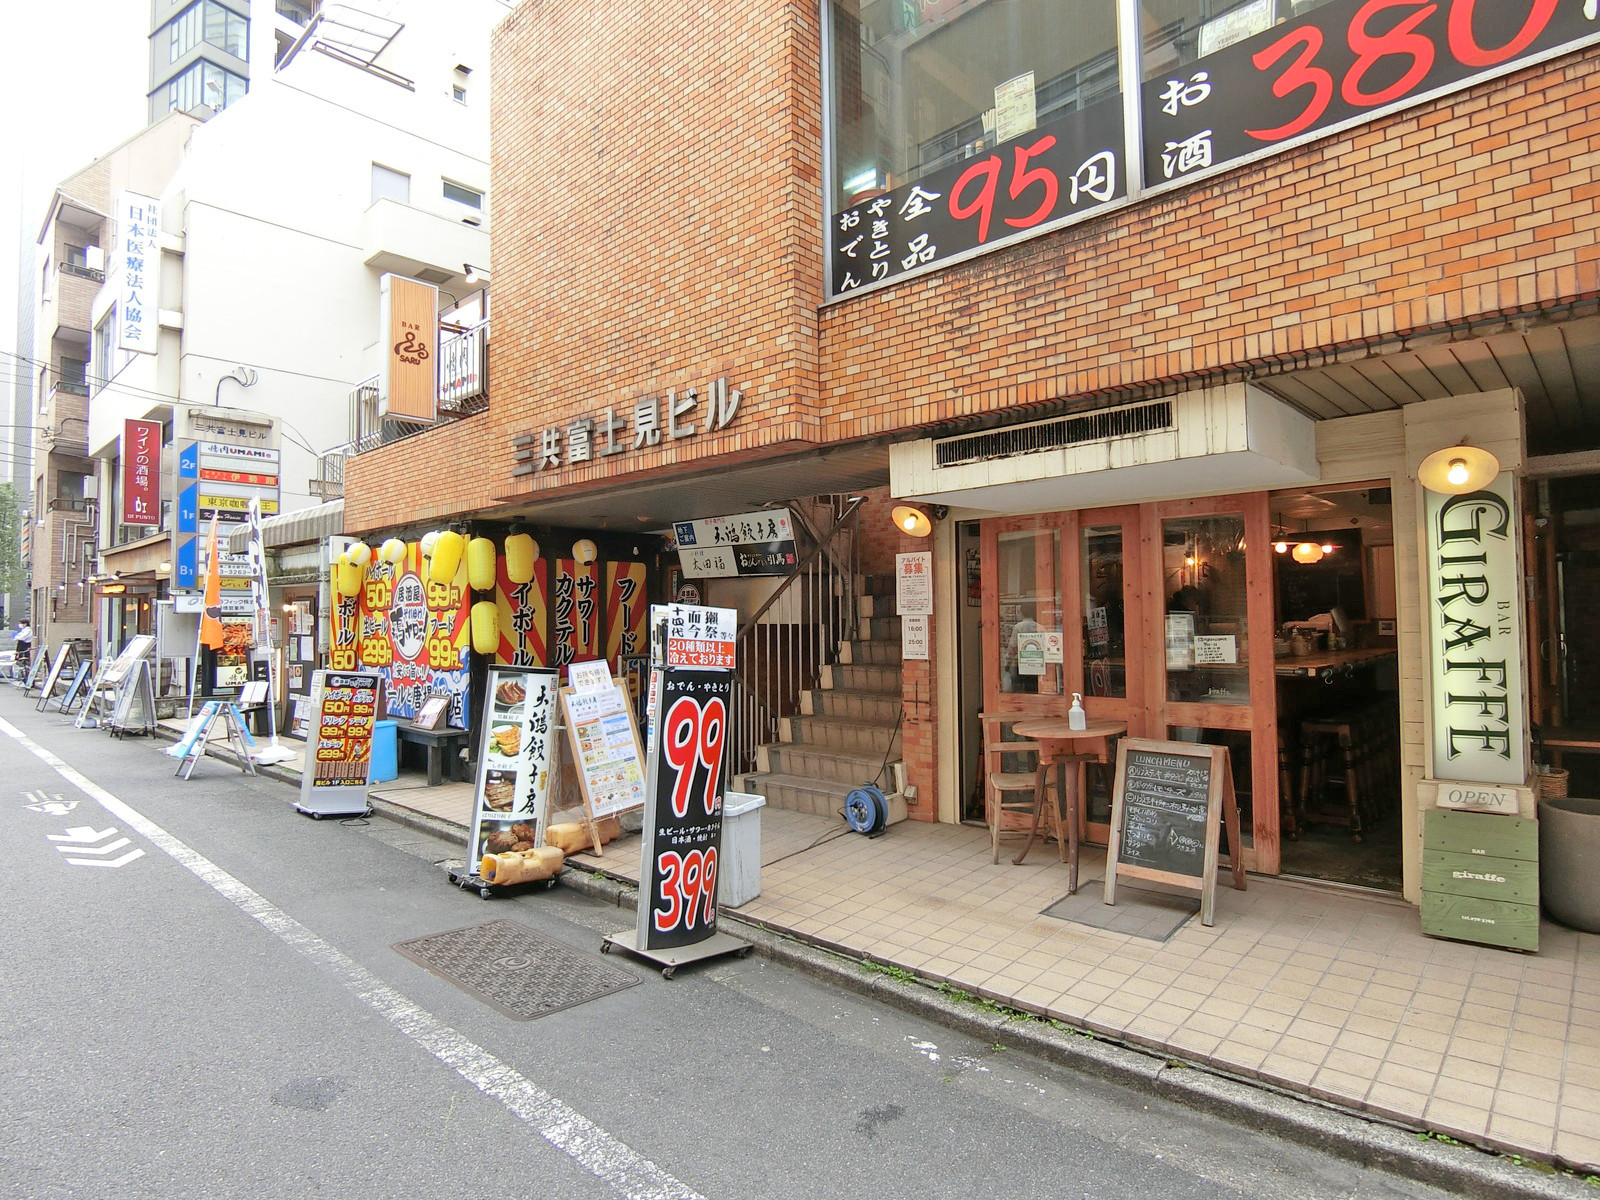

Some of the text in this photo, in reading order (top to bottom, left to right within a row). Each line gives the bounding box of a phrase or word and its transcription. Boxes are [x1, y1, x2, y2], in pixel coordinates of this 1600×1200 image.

[1158, 71, 1213, 179] お酒
[147, 203, 158, 249] 社団法人
[899, 185, 942, 272] 全品
[866, 197, 892, 281] やきとり
[839, 210, 865, 292] おでん
[124, 204, 145, 341] 日本医療法人協会
[401, 320, 420, 331] BAR
[399, 355, 421, 366] SARU
[194, 423, 267, 440] 三共富士見ビル
[512, 376, 744, 478] 三共富士見ビル
[181, 459, 196, 470] 2F
[182, 509, 195, 520] 1F
[692, 555, 726, 571] 太田福
[901, 556, 926, 564] アルバイト
[180, 565, 194, 576] B1
[903, 563, 923, 575] 募集
[397, 585, 421, 602] 居酒屋
[576, 575, 596, 646] サワー
[617, 577, 637, 656] フード
[1496, 600, 1512, 635] BAR
[363, 616, 388, 637] 生ビール
[430, 614, 456, 636] フード
[555, 572, 575, 667] カクテル
[671, 606, 685, 638] 十四代
[688, 608, 702, 639] 而今
[1435, 489, 1511, 761] GIRAFFE
[362, 638, 393, 665] 299円
[669, 639, 725, 654] 20種類以上
[669, 652, 734, 666] 冷えております
[576, 668, 606, 679] お持ち帰り
[324, 690, 352, 700] ハイボール
[324, 701, 350, 713] 50円
[353, 704, 374, 714] 99円
[322, 716, 347, 726] ドリンク
[349, 717, 368, 726] フード
[320, 740, 343, 749] 生ビール
[318, 749, 346, 759] 299円
[1135, 755, 1191, 769] LUNCH MENU
[1449, 789, 1507, 807] OPEN
[1452, 870, 1506, 883] giraffe
